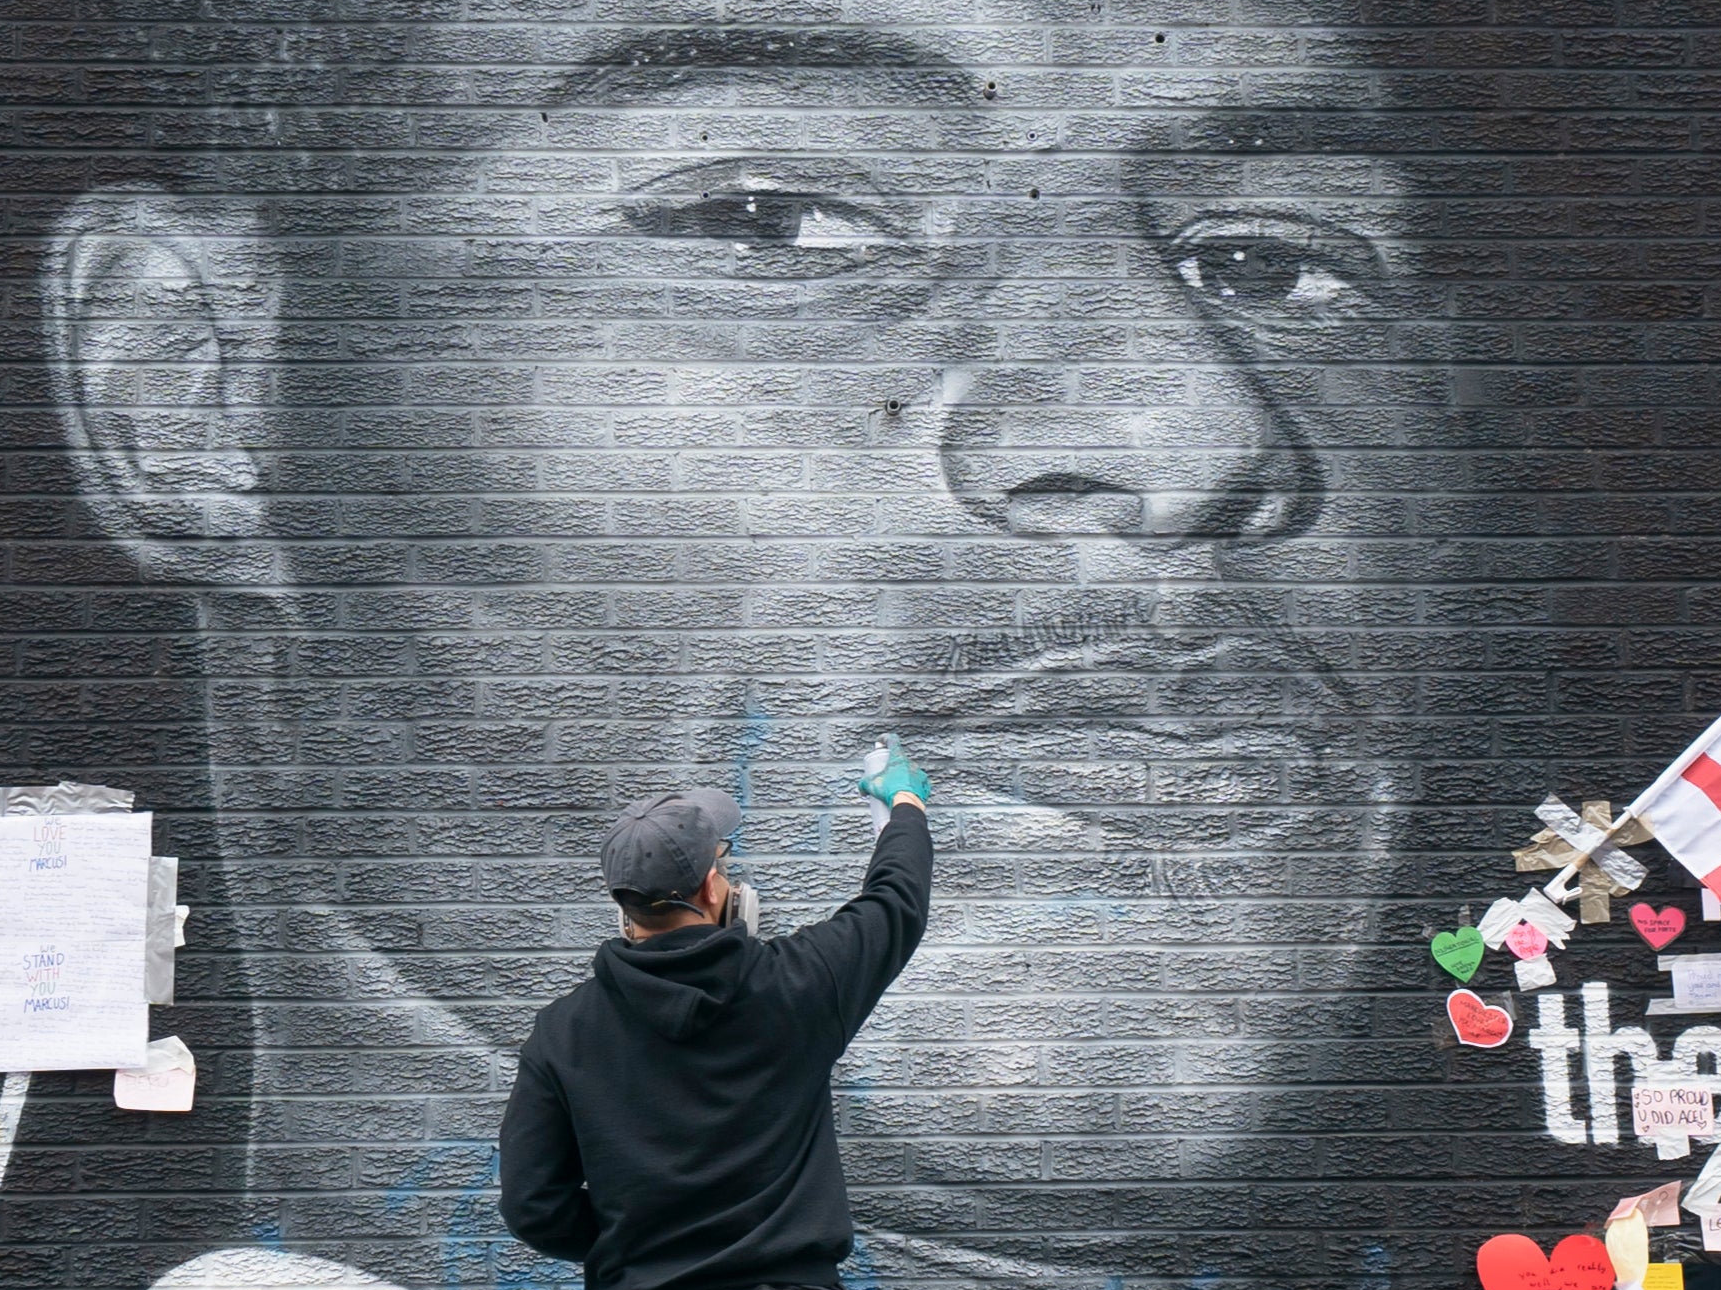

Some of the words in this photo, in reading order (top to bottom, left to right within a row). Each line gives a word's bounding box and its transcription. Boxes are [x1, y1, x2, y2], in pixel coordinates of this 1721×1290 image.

[1641, 1090, 1665, 1104] SO
[1669, 1091, 1709, 1106] PROUD
[1638, 1110, 1648, 1124] U
[1651, 1111, 1674, 1125] DID
